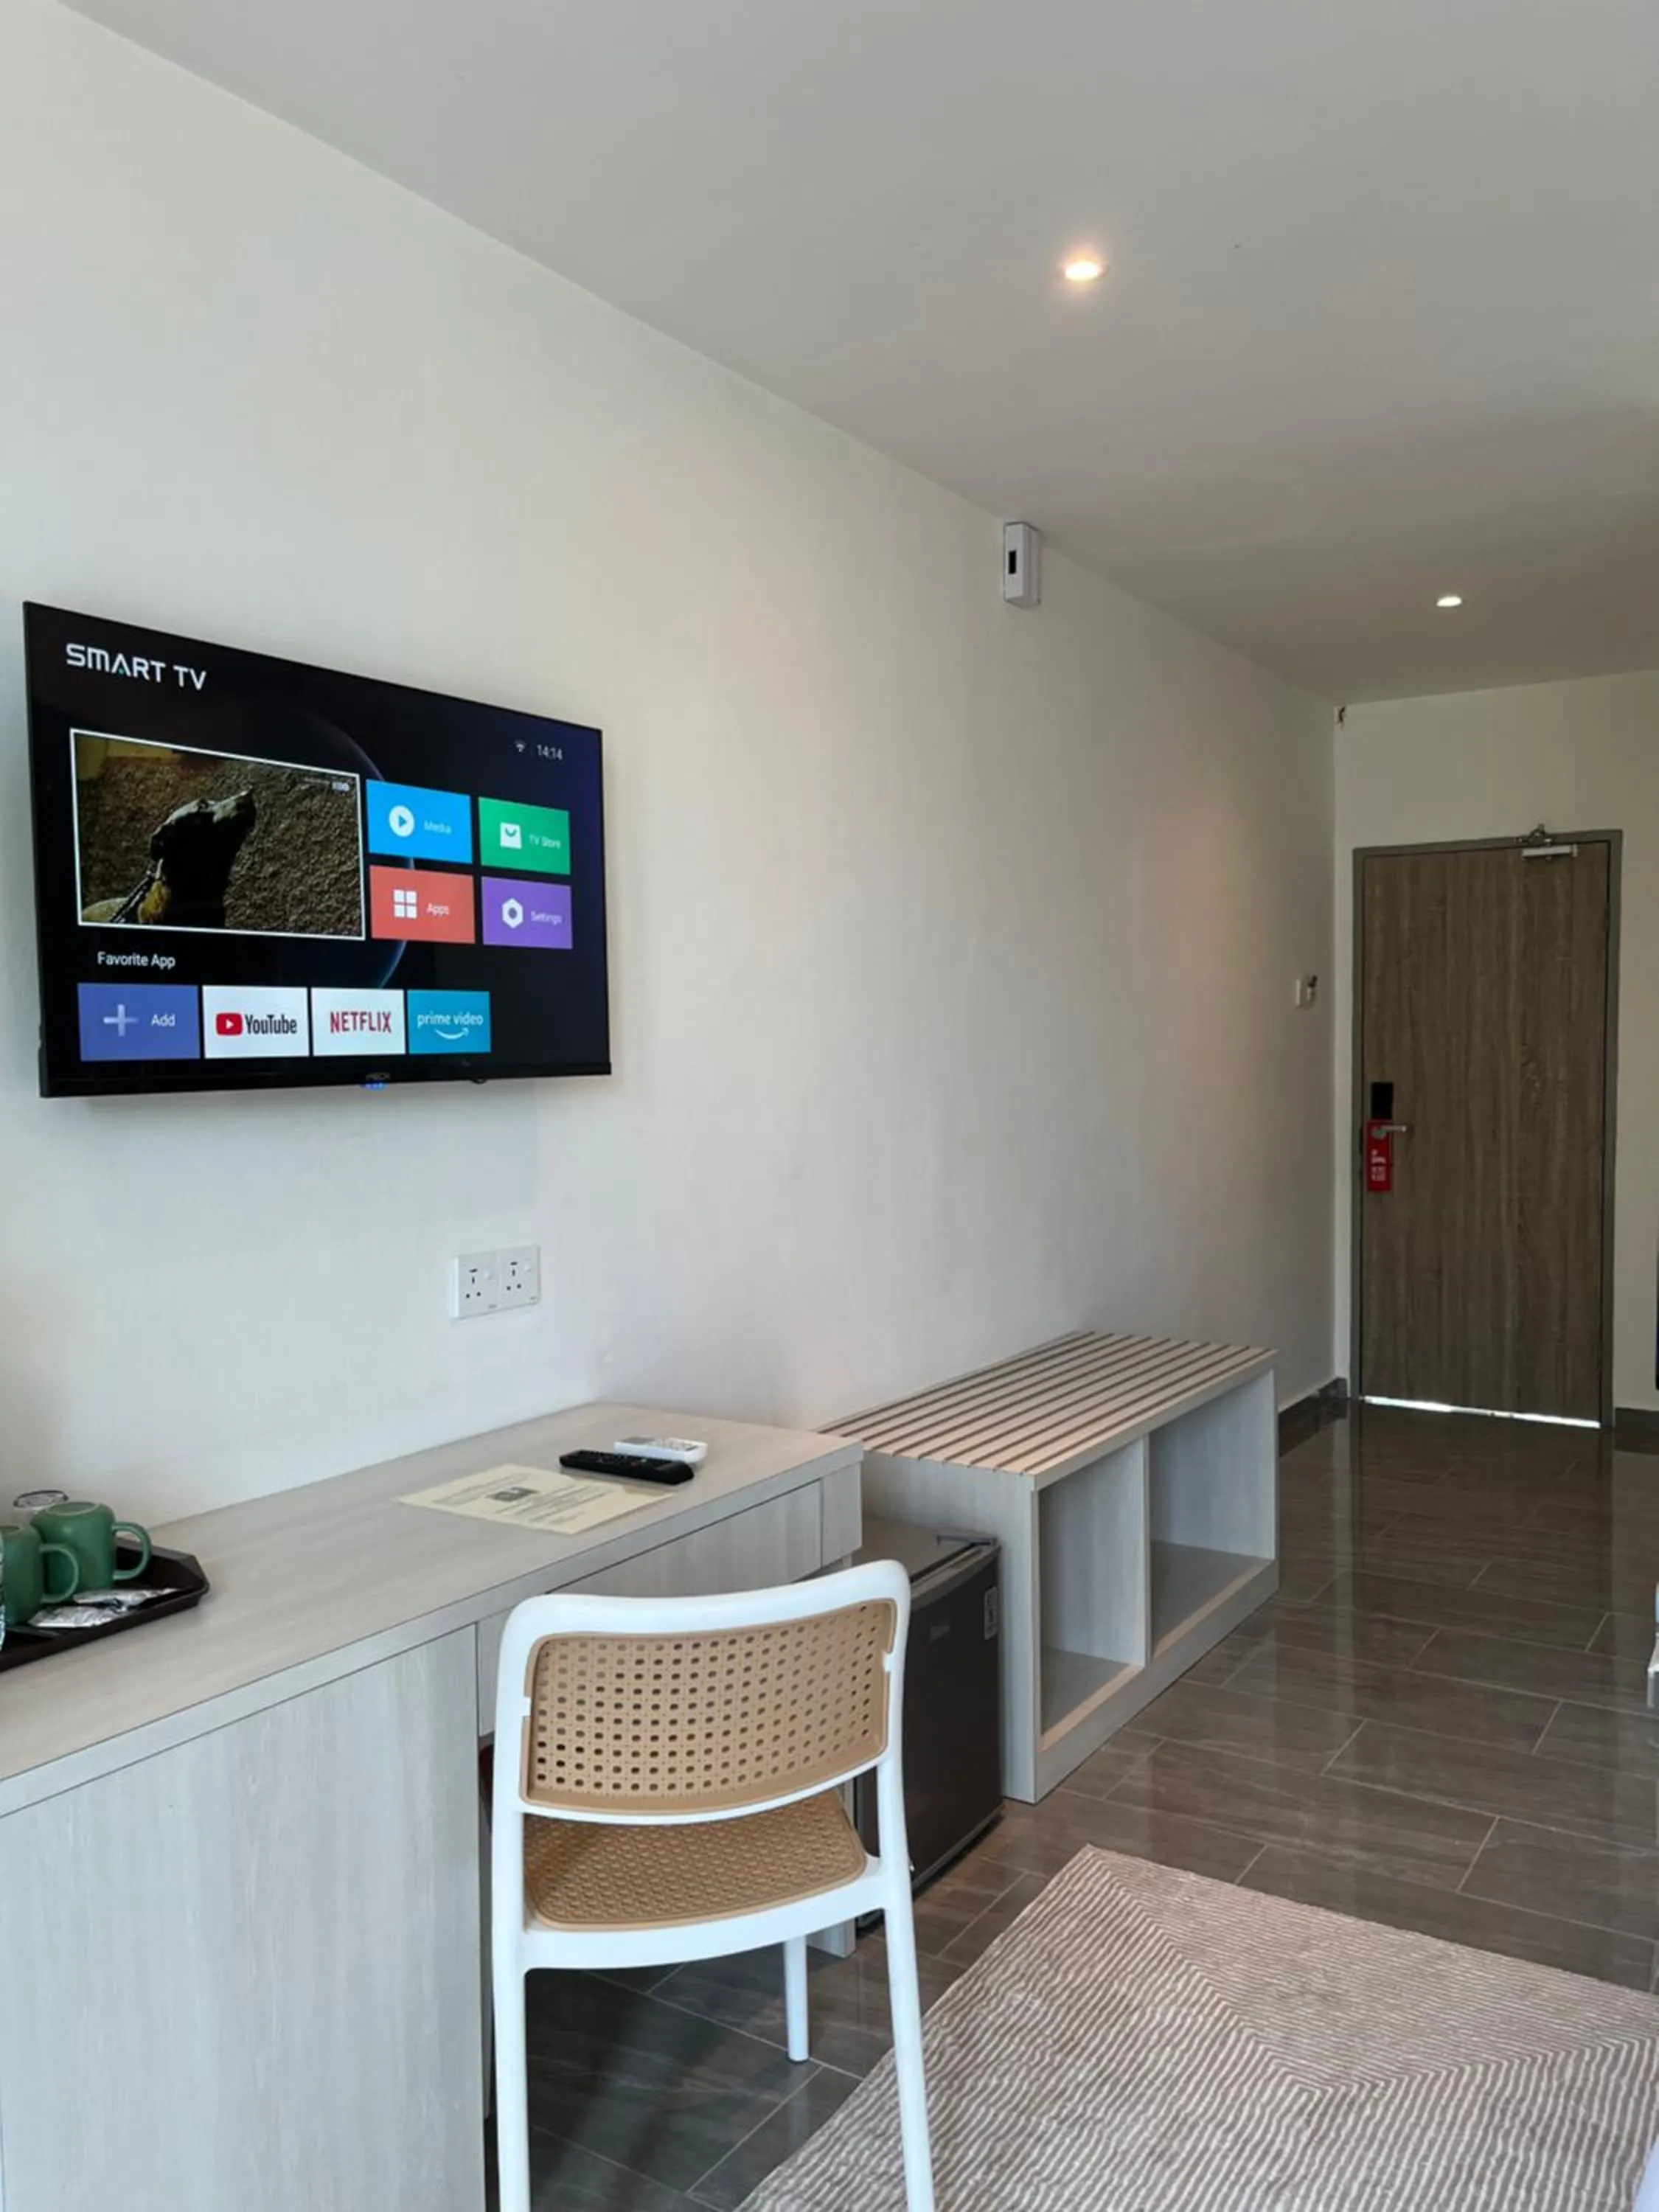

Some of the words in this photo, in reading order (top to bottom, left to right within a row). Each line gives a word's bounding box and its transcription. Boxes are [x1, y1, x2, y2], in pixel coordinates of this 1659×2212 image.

[66, 643, 166, 683] SMART
[173, 665, 206, 690] TV
[423, 819, 452, 834] Media
[529, 834, 540, 846] TV
[427, 902, 449, 917] Apps
[97, 951, 149, 967] Favorite
[150, 953, 176, 970] App
[150, 1013, 176, 1027] Add
[244, 1013, 298, 1035] YouTube
[330, 1011, 392, 1034] NETFLIX
[417, 1010, 452, 1028] prime
[453, 1011, 484, 1026] video
